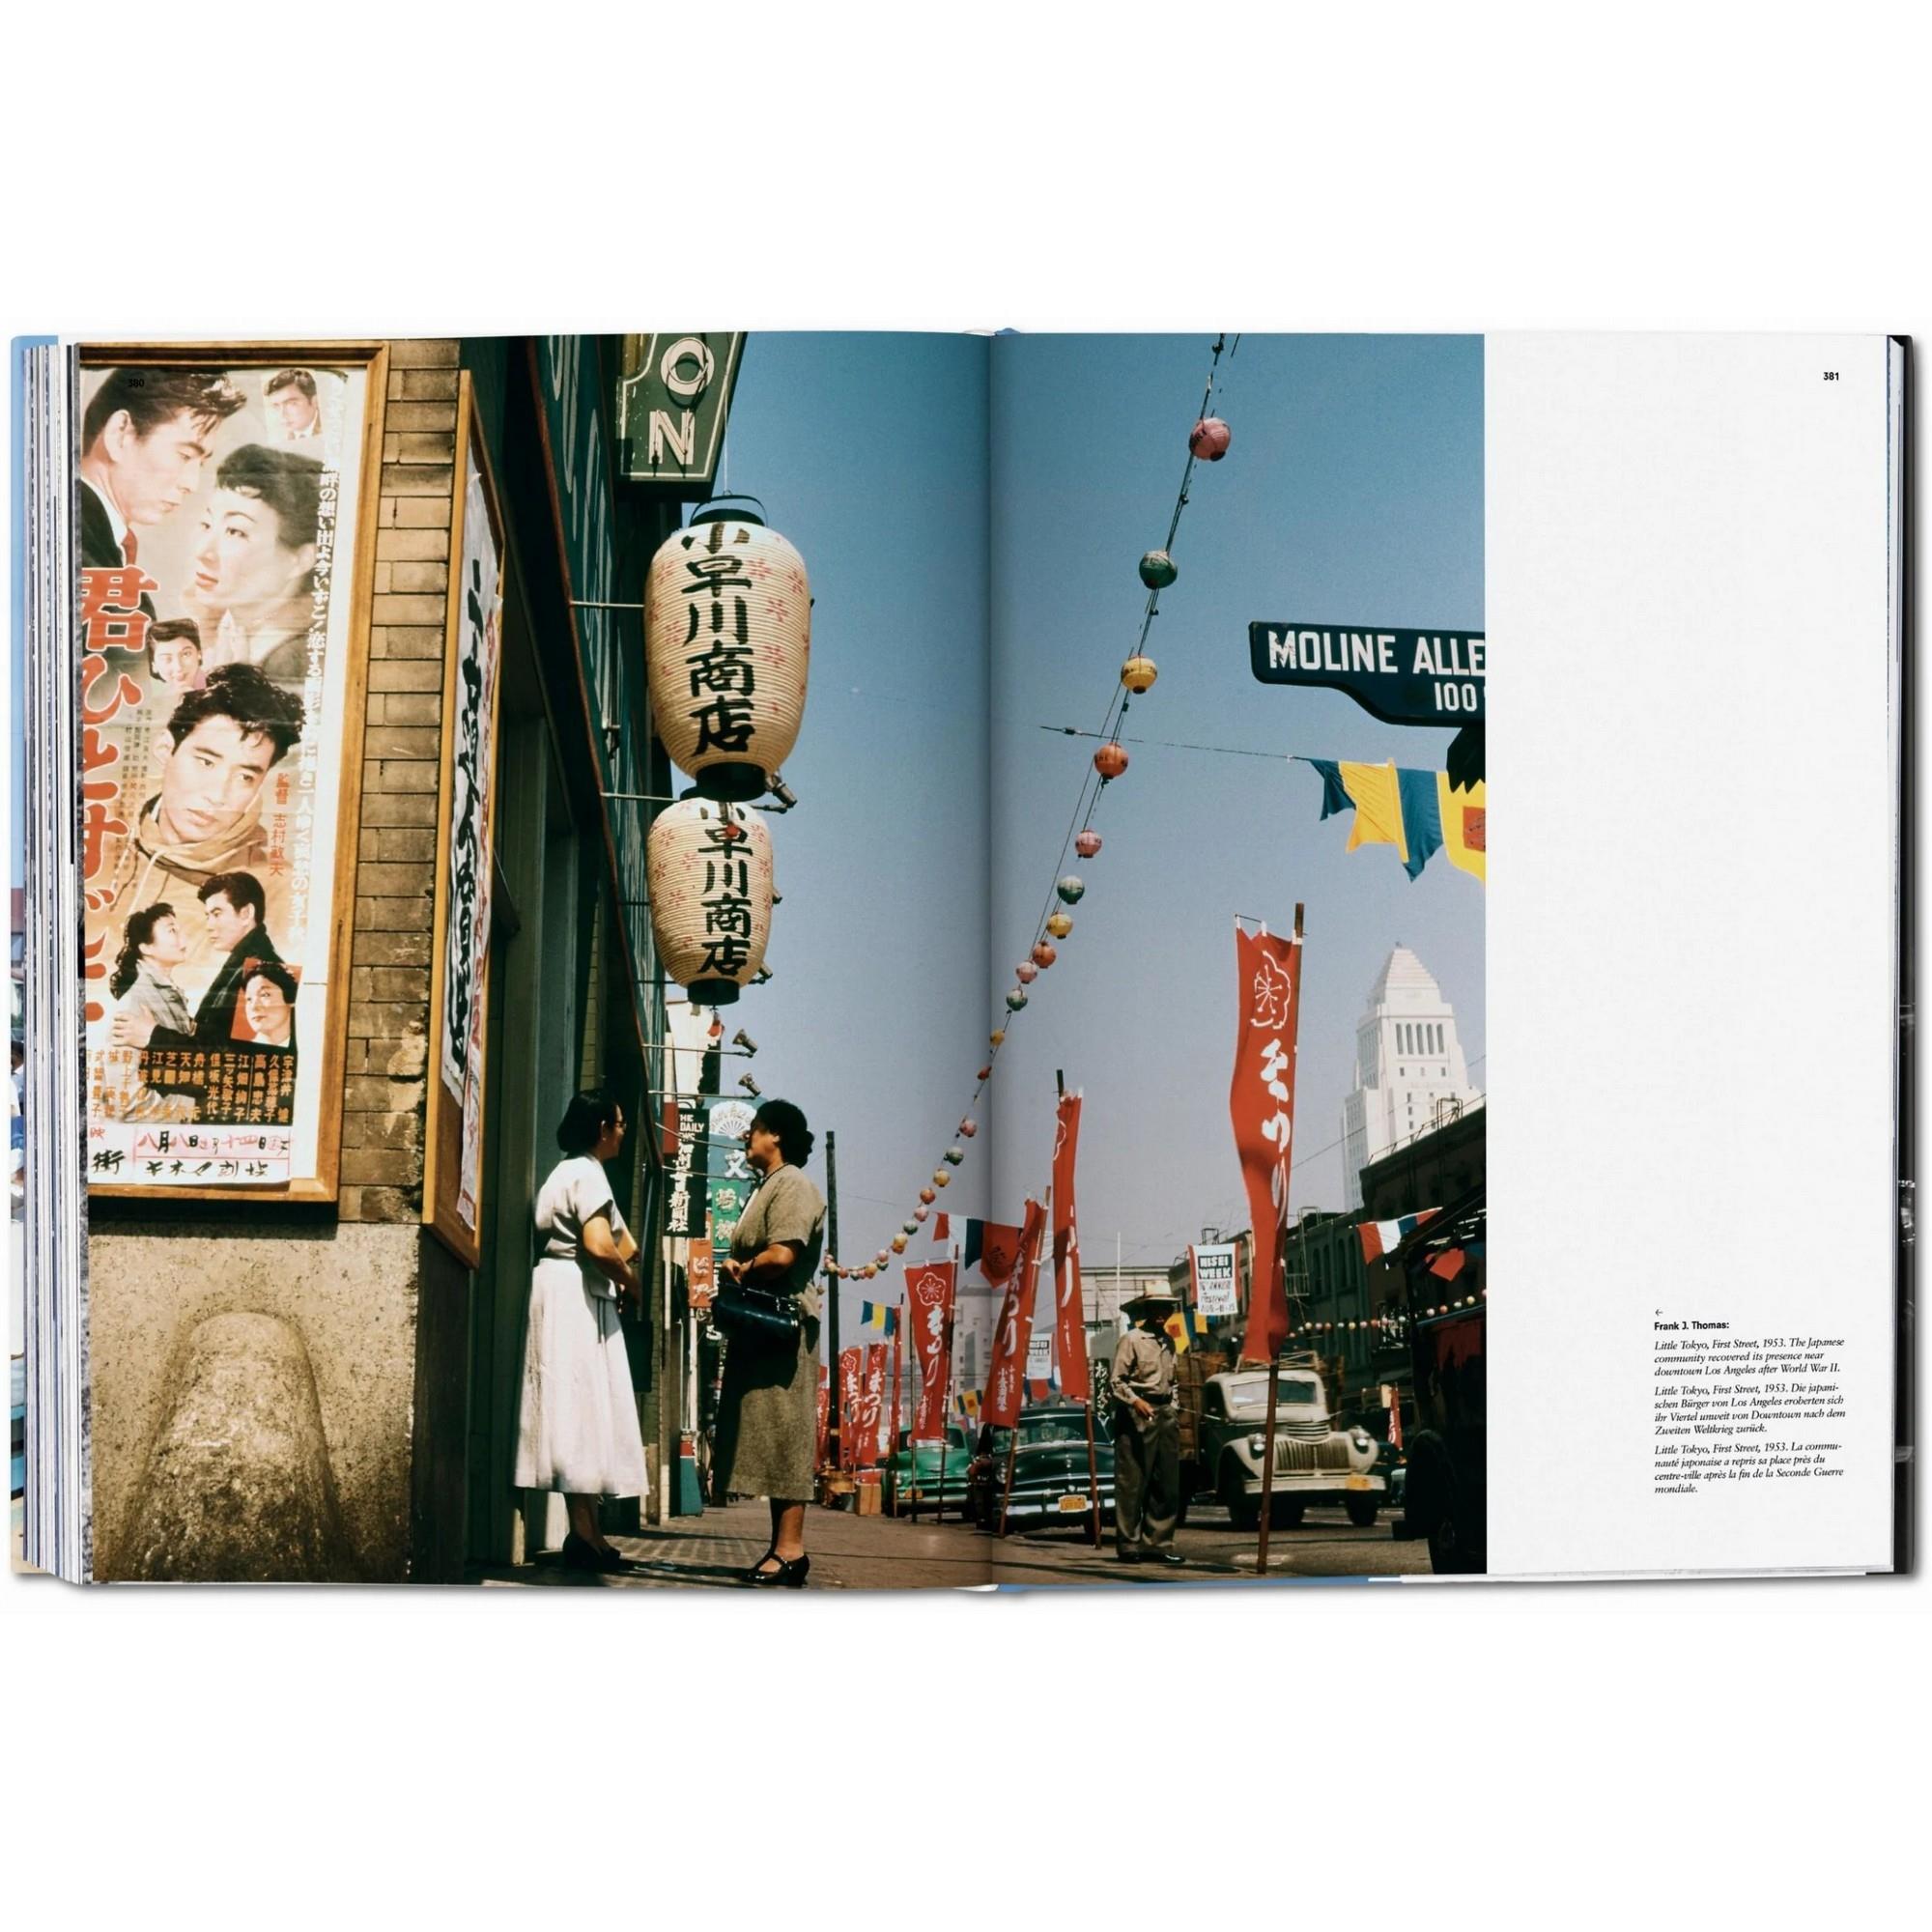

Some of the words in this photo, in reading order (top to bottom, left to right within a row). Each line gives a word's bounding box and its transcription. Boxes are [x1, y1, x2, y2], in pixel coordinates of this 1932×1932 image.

[127, 378, 145, 388] 380
[1823, 371, 1839, 381] 381
[649, 338, 715, 465] ON
[681, 523, 755, 757] 小早川商店
[1268, 630, 1398, 673] MOLINE
[1412, 636, 1485, 676] ALLE
[1435, 681, 1477, 712] 100
[698, 801, 753, 977] 小早川商店
[679, 1122, 705, 1133] DAILY
[1200, 1256, 1229, 1267] NISEI
[1199, 1267, 1232, 1278] WEEK
[1654, 1321, 1679, 1330] Frank
[1682, 1321, 1689, 1330] J.
[926, 1304, 945, 1387] まつり
[1655, 1341, 1678, 1350] Little
[1681, 1340, 1709, 1351] Tokyo,
[1713, 1340, 1731, 1349] First
[1733, 1339, 1759, 1349] Street,
[1763, 1338, 1786, 1348] 1953.
[1789, 1337, 1805, 1347] The
[1806, 1337, 1844, 1349] Japanese
[1655, 1353, 1705, 1364] community
[1708, 1351, 1750, 1362] recovered
[1765, 1353, 1802, 1362] presence
[1655, 1367, 1702, 1376] downtown
[1705, 1366, 1720, 1375] Los
[1723, 1365, 1756, 1377] Angeles
[1758, 1364, 1778, 1376] after
[1781, 1363, 1807, 1373] World
[1810, 1363, 1828, 1372] War
[1831, 1363, 1839, 1372] II.
[1655, 1386, 1678, 1396] Little
[1681, 1385, 1710, 1397] Tokyo,
[1713, 1385, 1732, 1394] First
[1734, 1384, 1760, 1394] Street,
[1765, 1383, 1788, 1393] 1953.
[1791, 1383, 1806, 1392] Die
[1808, 1383, 1838, 1394] japani-
[862, 1368, 883, 1428] まつり
[1655, 1399, 1678, 1408] schen
[1681, 1399, 1710, 1409] Bürger
[1731, 1398, 1747, 1406] Los
[1749, 1396, 1782, 1408] Angeles
[1784, 1396, 1825, 1406] eroberten
[1827, 1395, 1843, 1405] sich
[1655, 1412, 1667, 1422] ihr
[1670, 1411, 1698, 1421] Viertel
[1700, 1411, 1730, 1421] unweit
[1751, 1410, 1801, 1419] Downtown
[1804, 1408, 1825, 1418] nach
[1827, 1408, 1845, 1417] dem
[1655, 1426, 1690, 1435] Zweiten
[1694, 1424, 1734, 1435] Weltkrieg
[1736, 1423, 1767, 1434] zurück.
[1655, 1445, 1678, 1455] Little
[1681, 1445, 1710, 1456] Tokyo,
[1713, 1444, 1732, 1453] First
[1734, 1443, 1760, 1453] Street,
[1765, 1442, 1788, 1452] 1953.
[1791, 1442, 1803, 1451] La
[1655, 1459, 1679, 1467] nauté
[1681, 1458, 1722, 1468] japonaise
[1732, 1457, 1756, 1467] repris
[1769, 1455, 1792, 1466] place
[1793, 1455, 1811, 1466] près
[1813, 1454, 1825, 1463] du
[1655, 1470, 1701, 1480] centre-ville
[1704, 1470, 1726, 1482] après
[1728, 1469, 1736, 1478] la
[1739, 1468, 1750, 1481] fin
[1752, 1468, 1763, 1478] de
[1766, 1468, 1774, 1477] la
[1776, 1467, 1811, 1477] Seconde
[1814, 1467, 1843, 1476] Guerre
[1655, 1483, 1698, 1494] mondiale.
